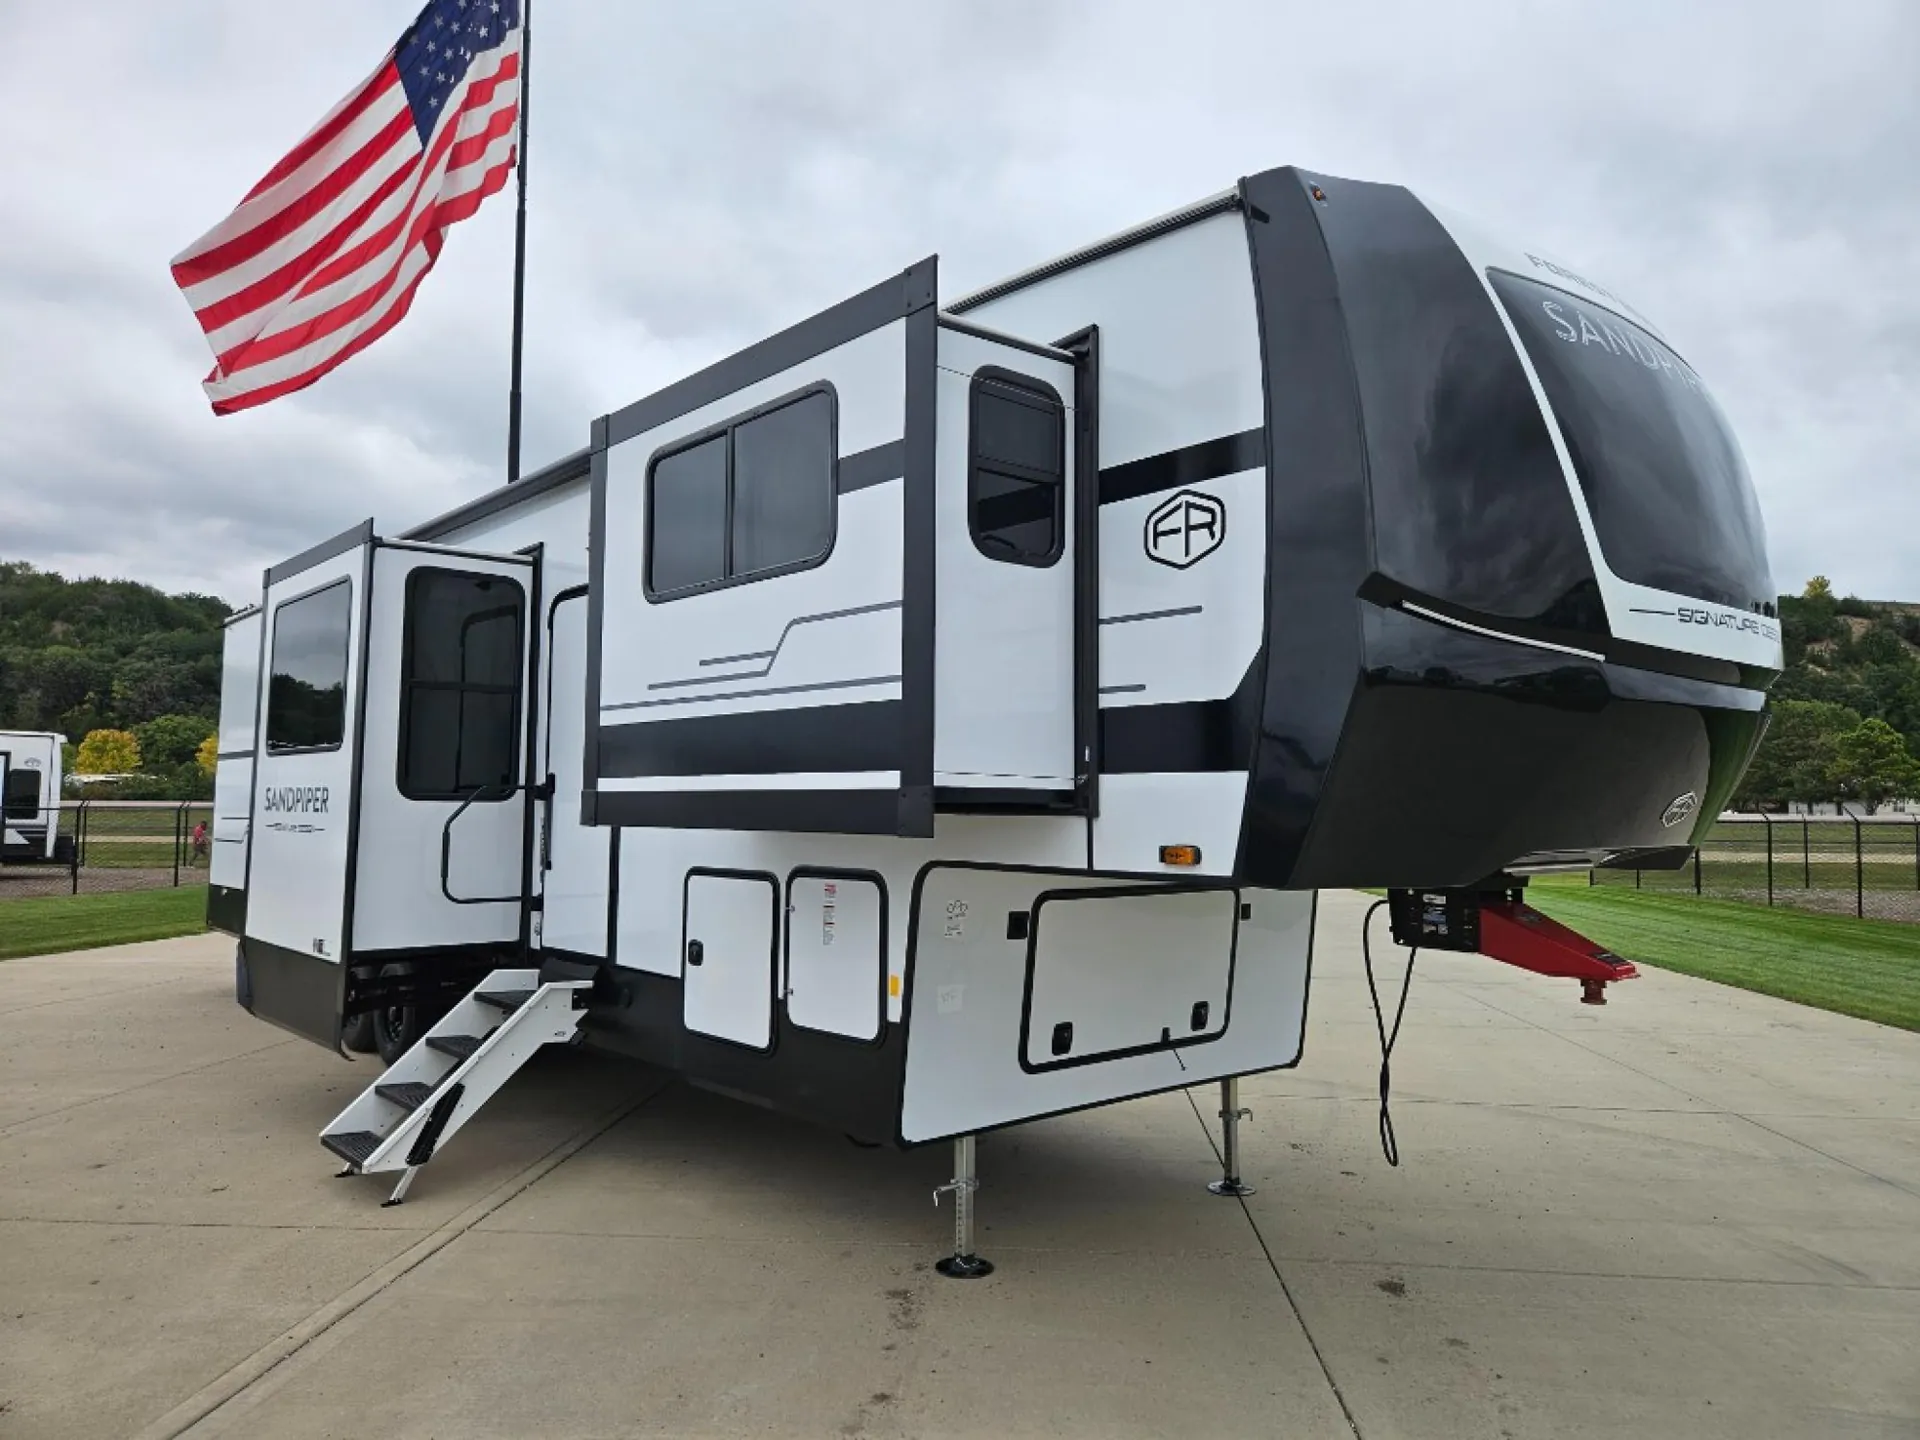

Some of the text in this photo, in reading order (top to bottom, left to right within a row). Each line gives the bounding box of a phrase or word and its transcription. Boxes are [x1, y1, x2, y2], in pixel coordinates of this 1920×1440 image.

[1152, 499, 1218, 558] FR
[1678, 607, 1760, 635] SIGNATURE
[264, 786, 329, 813] SANDPIPER
